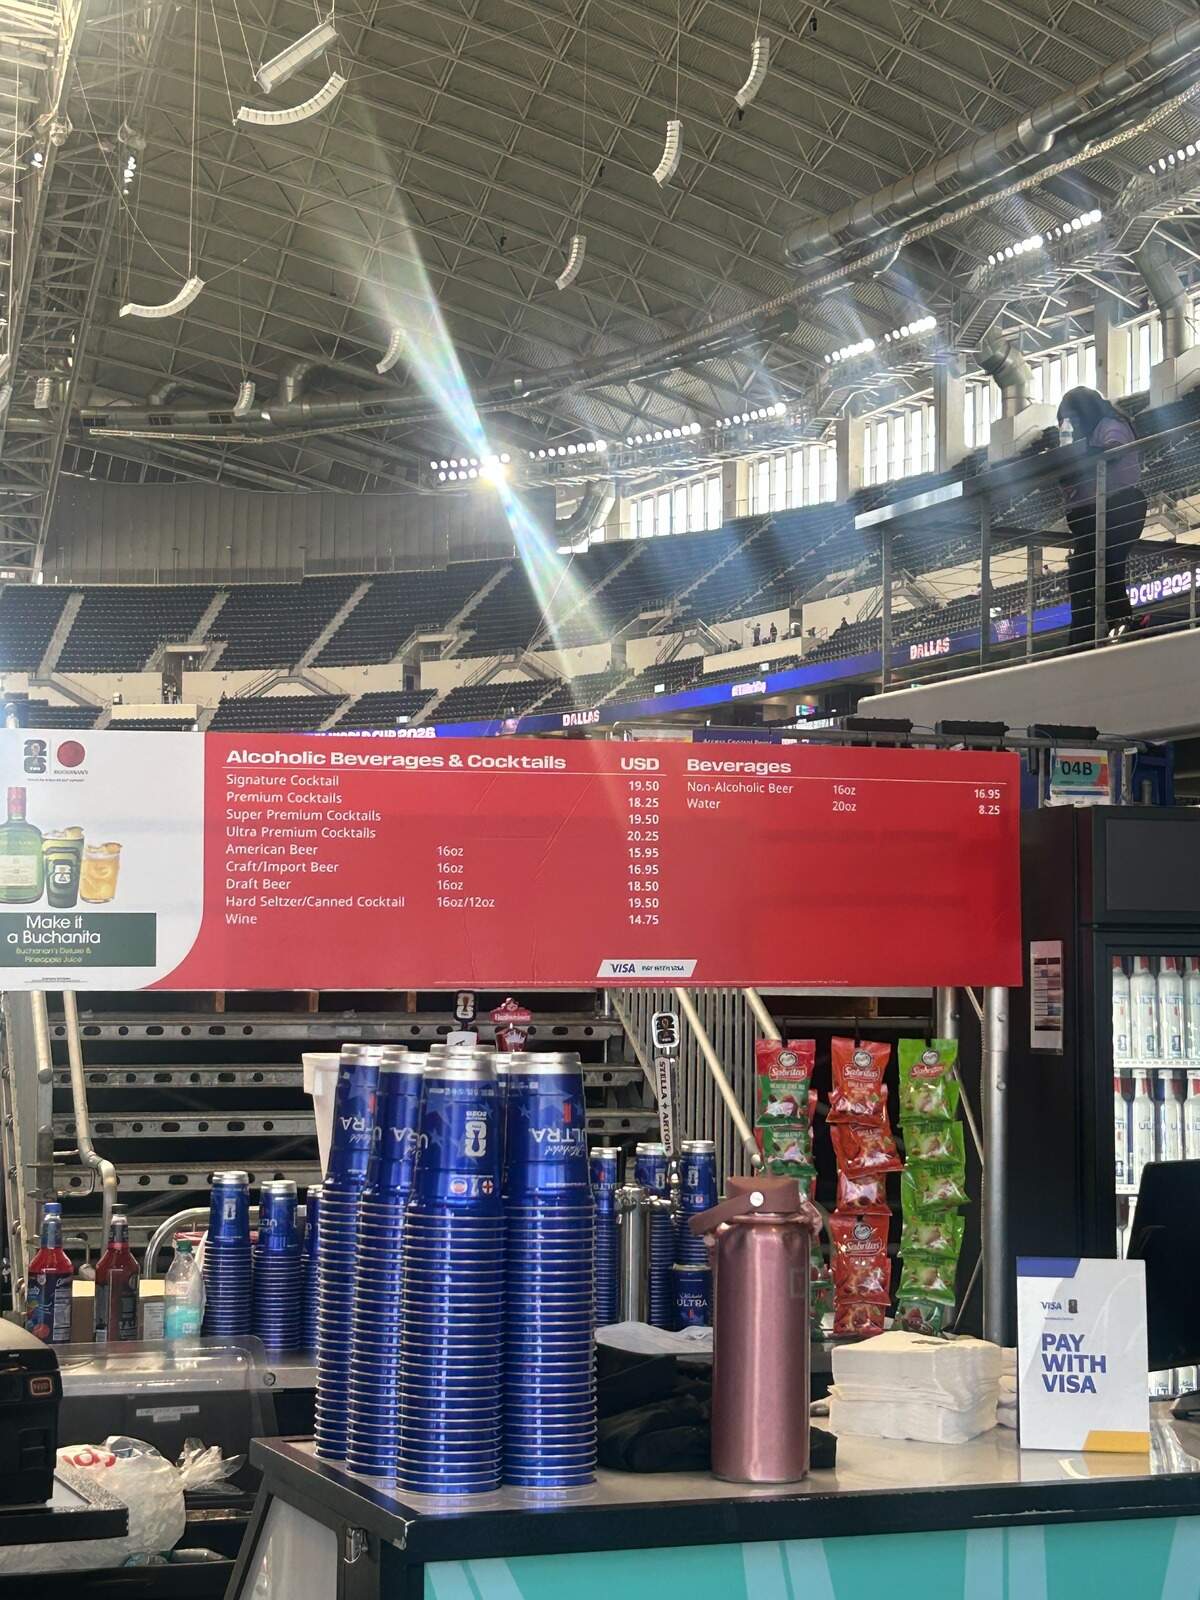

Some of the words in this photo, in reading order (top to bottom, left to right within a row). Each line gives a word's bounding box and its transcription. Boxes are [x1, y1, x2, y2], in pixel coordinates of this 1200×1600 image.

[1140, 580, 1161, 602] CUP
[910, 637, 950, 659] DALLAS
[562, 709, 600, 727] DALLAS
[227, 750, 325, 764] Alcoholic
[331, 752, 444, 769] Beverages
[449, 755, 463, 767] &
[468, 755, 566, 769] Cocktails
[621, 758, 659, 770] USD
[687, 759, 791, 775] Beverages
[1061, 761, 1093, 776] 04B
[227, 774, 286, 788] Signature
[291, 775, 338, 786] Cocktail
[629, 781, 659, 791] 19.50
[688, 782, 764, 793] Non-Alcoholic
[769, 783, 793, 793] Beer
[834, 785, 855, 795] 16oz
[227, 791, 283, 802] Premium
[288, 792, 342, 803] Cocktails
[975, 789, 1000, 799] 16.95
[629, 798, 658, 807] 18.25
[687, 799, 720, 808] Water
[833, 801, 856, 811] 20oz
[226, 809, 262, 822] Super
[267, 810, 322, 820] Premium
[327, 810, 381, 821] Cocktails
[979, 805, 1000, 815] 8.25
[629, 814, 659, 824] 19.50
[227, 826, 256, 837] Ultra
[262, 827, 317, 837] Premium
[322, 827, 375, 838] Cocktails
[627, 831, 659, 841] 20.25
[226, 844, 285, 854] American
[290, 844, 318, 855] Beer
[438, 846, 463, 856] 16oz
[629, 848, 659, 857] 15.95
[226, 861, 306, 874] Craft/Import
[311, 862, 339, 872] Beer
[438, 863, 463, 873] 16oz
[628, 865, 659, 874] 16.95
[226, 878, 258, 889] Draft
[263, 879, 291, 889] Beer
[438, 880, 463, 890] 16oz
[628, 881, 659, 891] 18.50
[226, 896, 256, 906] Hard
[261, 896, 352, 907] Seltzer/Canned
[357, 896, 404, 907] Cocktail
[437, 897, 495, 907] 16oz/12oz
[629, 898, 659, 908] 19.50
[26, 915, 71, 929] Make
[74, 915, 83, 929] it
[226, 913, 257, 924] Wine
[629, 915, 658, 924] 14.75
[7, 932, 18, 944] a
[23, 930, 101, 944] Buchanita
[611, 963, 636, 973] VISA
[659, 1061, 669, 1100] STELLA
[1041, 1301, 1062, 1310] VISA
[1042, 1333, 1085, 1352] PAY
[1042, 1354, 1106, 1373] WITH
[1042, 1374, 1097, 1394] VISA
